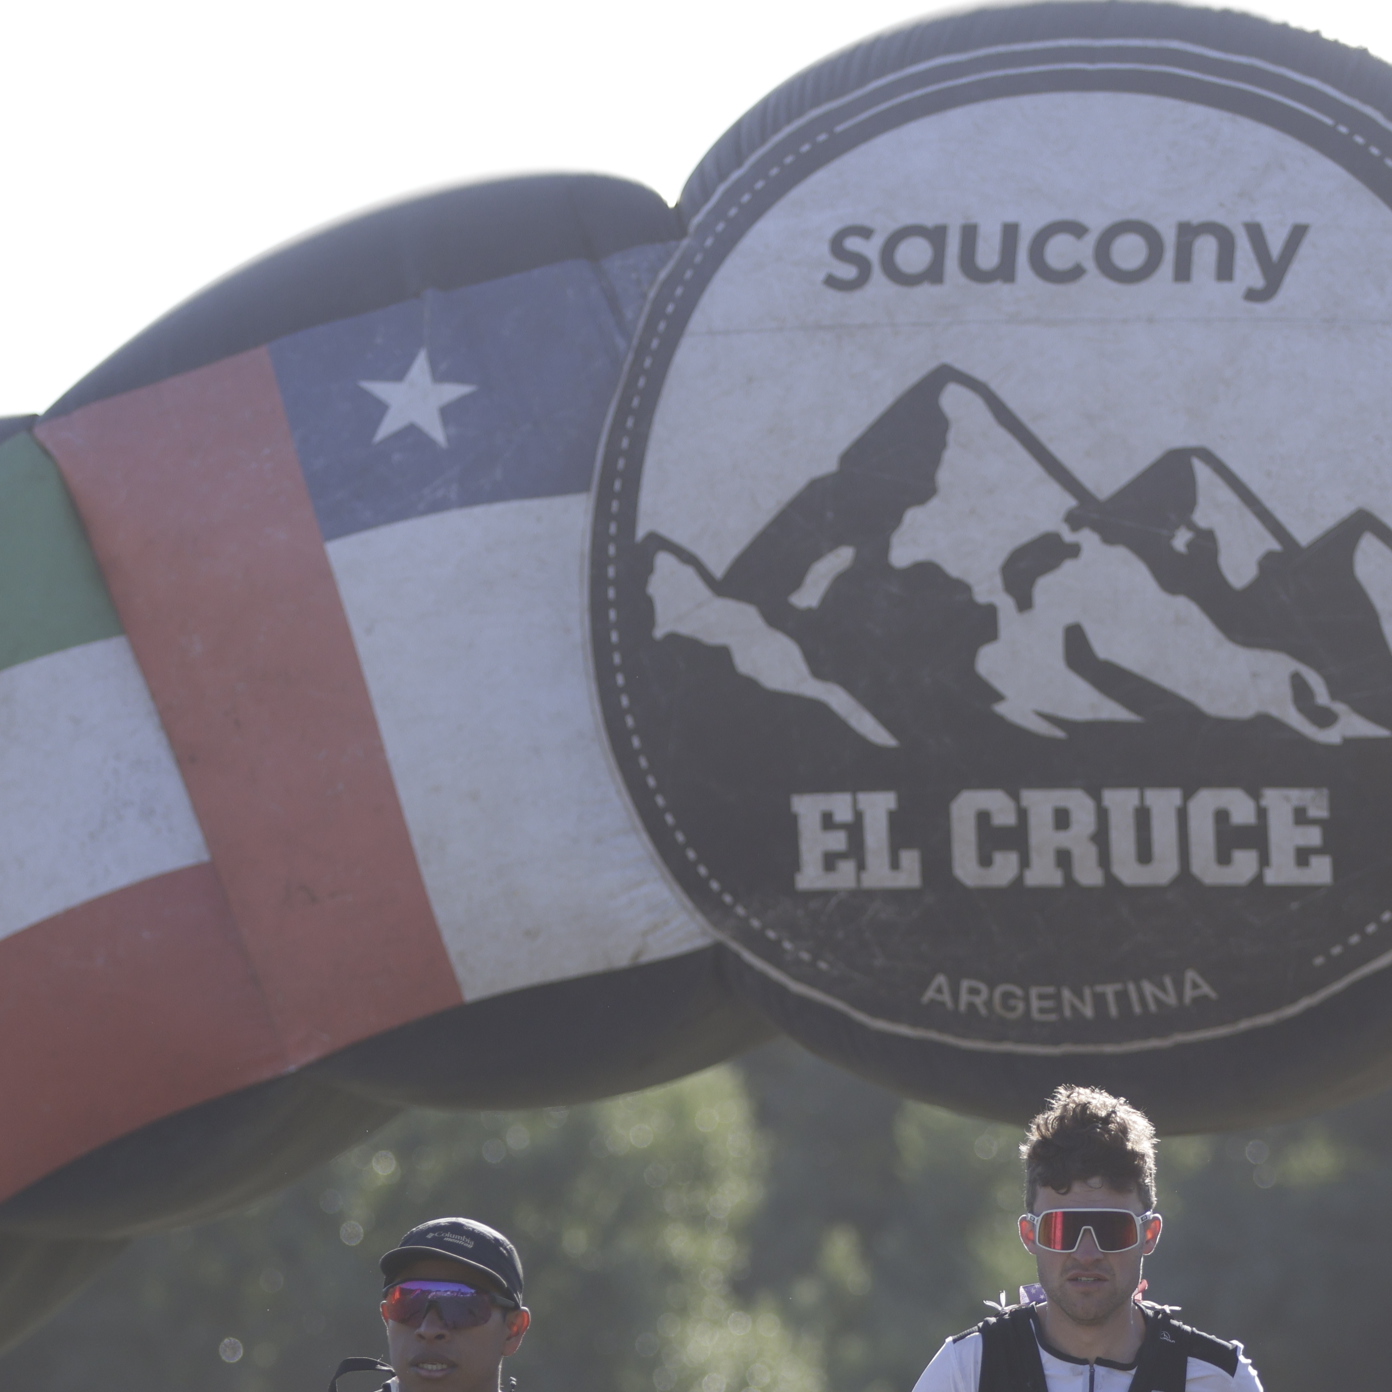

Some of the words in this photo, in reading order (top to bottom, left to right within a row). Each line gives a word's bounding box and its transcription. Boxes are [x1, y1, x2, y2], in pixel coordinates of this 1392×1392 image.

[821, 216, 1311, 303] saucony
[790, 790, 923, 892] EL
[949, 786, 1334, 890] CRUCE
[919, 966, 1219, 1024] ARGENTINA
